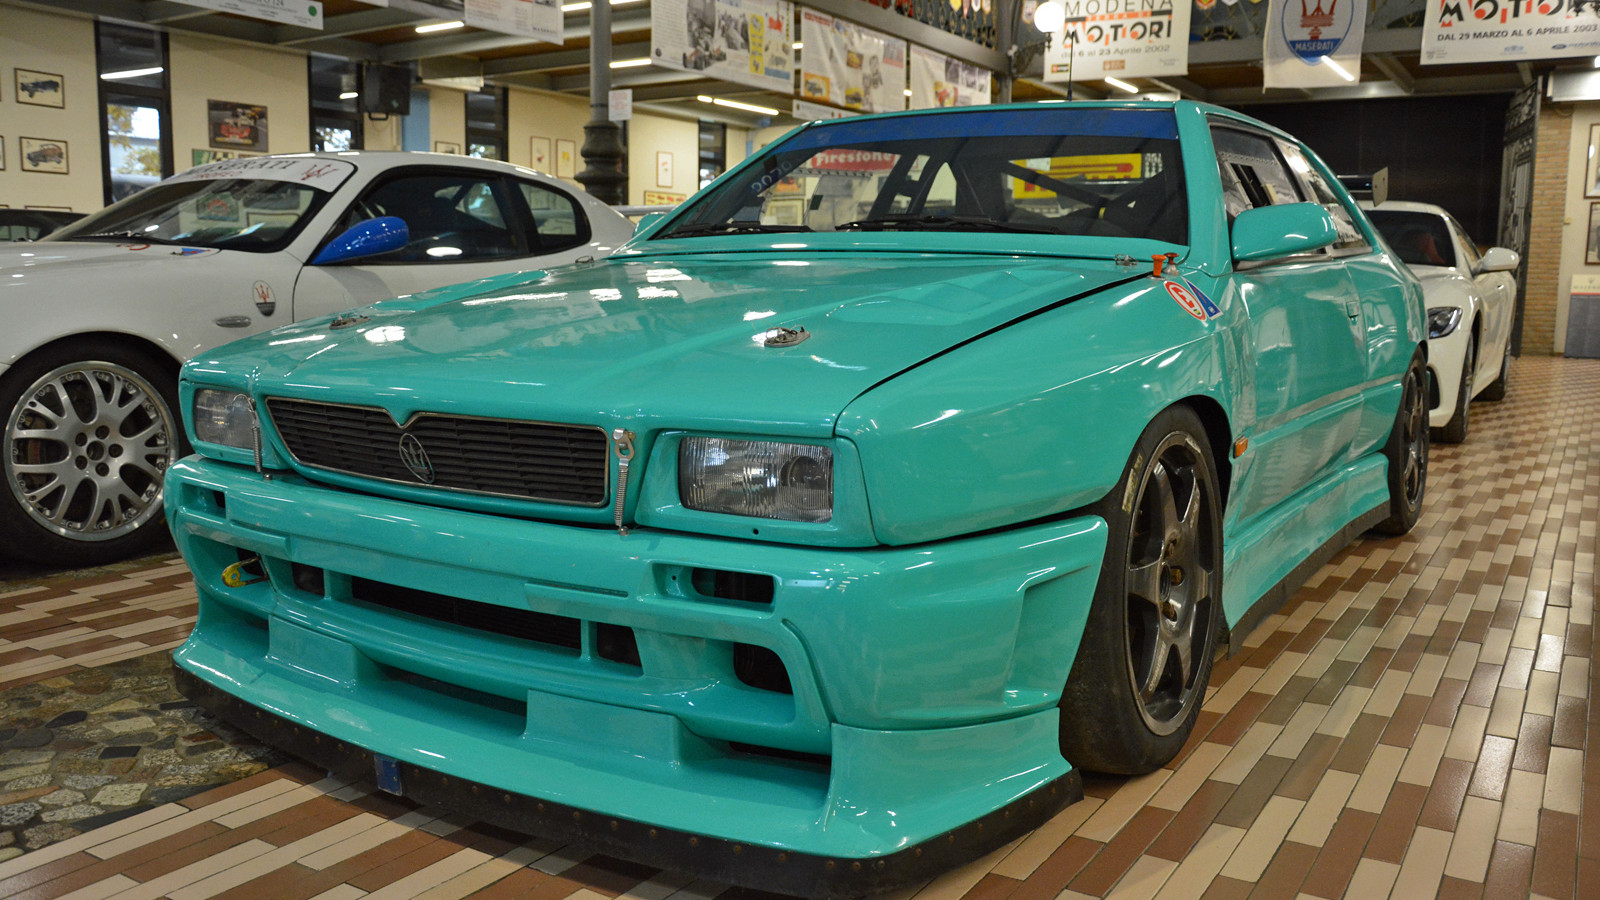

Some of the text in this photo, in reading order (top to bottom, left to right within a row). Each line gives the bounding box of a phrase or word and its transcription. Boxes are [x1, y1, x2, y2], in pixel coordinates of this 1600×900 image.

[1064, 0, 1173, 16] MODENA
[1062, 18, 1173, 46] MOTORI
[1437, 23, 1598, 42] DAL 29 MARZO AL 6 APRILE 2003
[1087, 49, 1096, 57] al
[1099, 48, 1111, 56] 23
[1113, 46, 1142, 55] Aprile
[1144, 44, 1171, 54] 2002
[1295, 41, 1334, 51] MASERATI
[815, 151, 893, 167] Firestone
